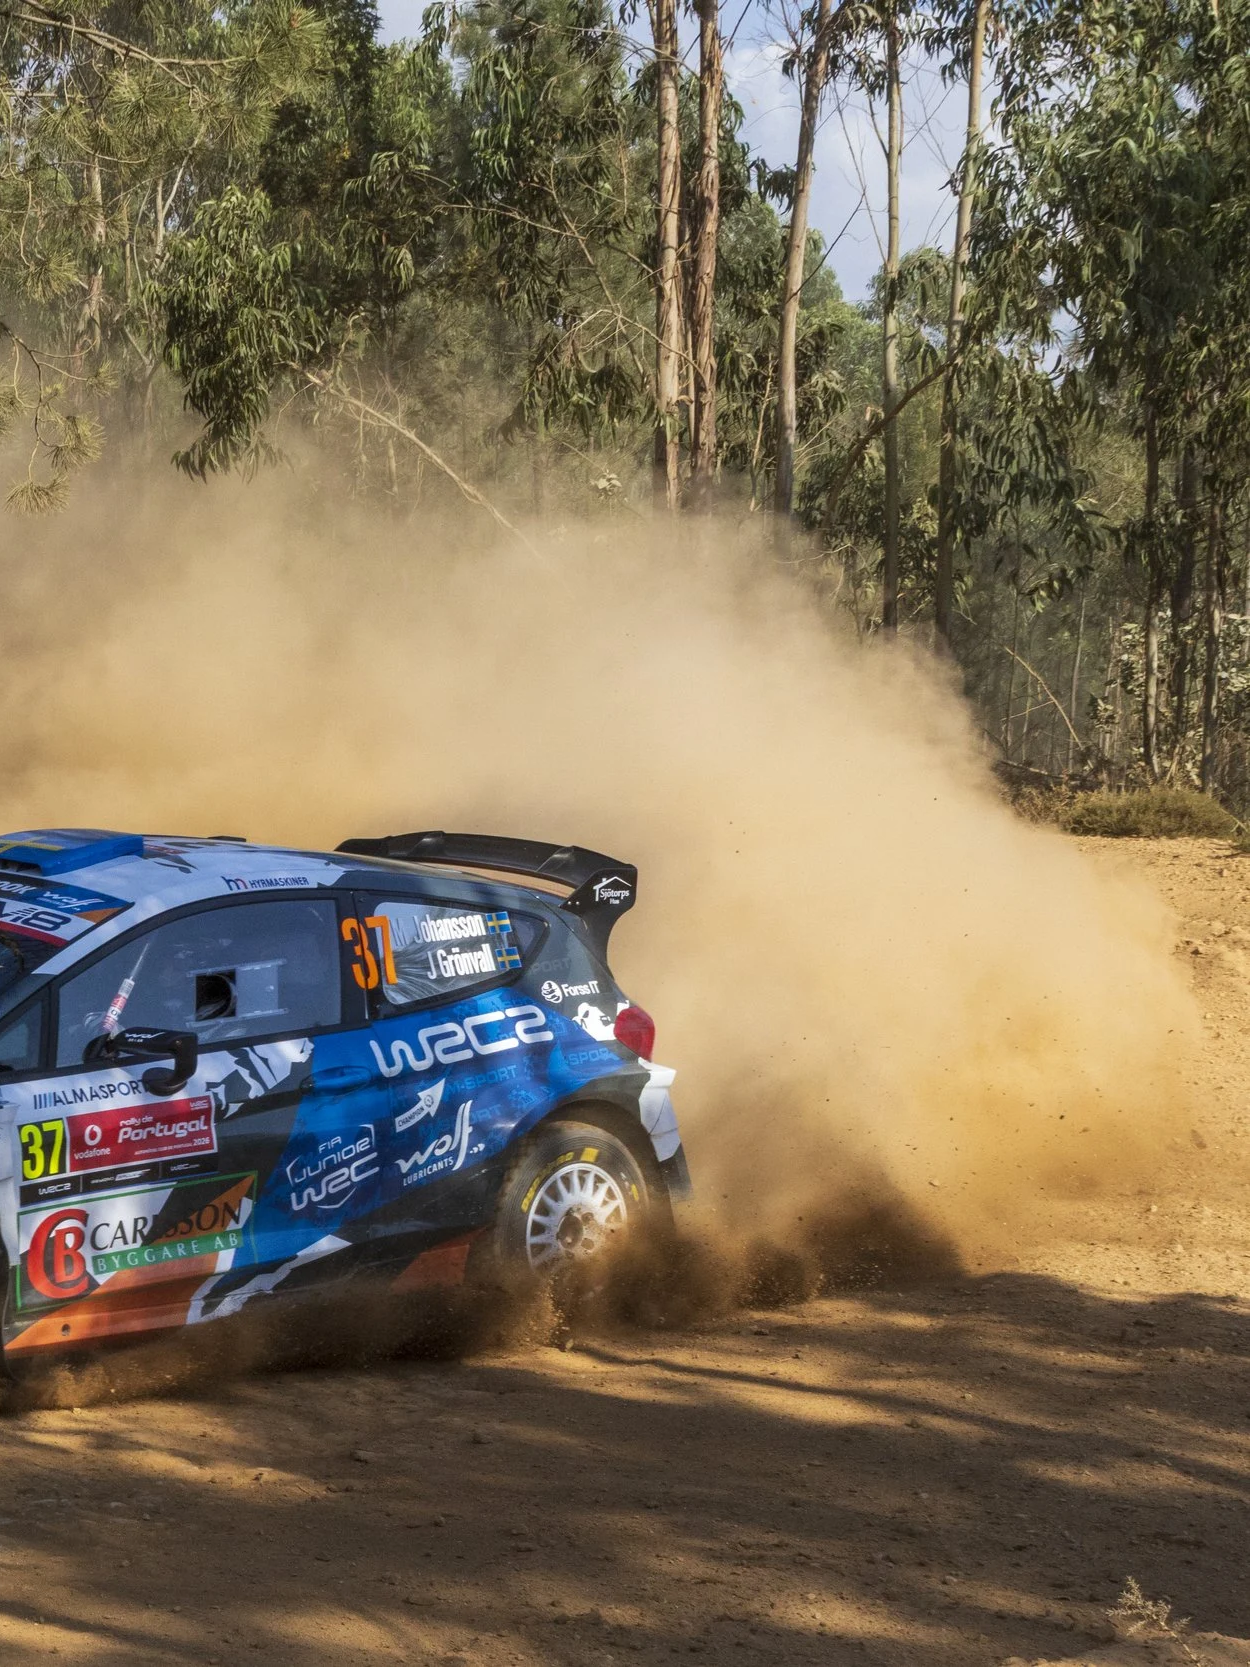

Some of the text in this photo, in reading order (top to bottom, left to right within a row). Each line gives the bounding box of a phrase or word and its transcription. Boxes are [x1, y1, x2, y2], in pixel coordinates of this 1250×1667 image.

[249, 876, 310, 890] HYRMASKINER
[599, 888, 630, 901] Sjötorps
[413, 914, 487, 944] Johansson
[340, 914, 399, 991] 37
[427, 943, 497, 980] J Grönvall
[561, 980, 601, 998] Forss IT
[369, 1004, 554, 1079] WRC2
[117, 1117, 209, 1144] Portugal
[397, 1106, 426, 1128] CHAMPION
[20, 1119, 65, 1180] 37
[318, 1135, 343, 1154] FIA
[394, 1099, 474, 1174] wolf
[73, 1146, 111, 1161] vodafone
[295, 1136, 372, 1183] JUNIOR
[290, 1151, 380, 1211] WRC
[402, 1156, 454, 1187] LUBRICANTS
[38, 1182, 72, 1196] WRC2
[90, 1198, 245, 1251] CARSON
[97, 1232, 239, 1272] BYGGARE AB
